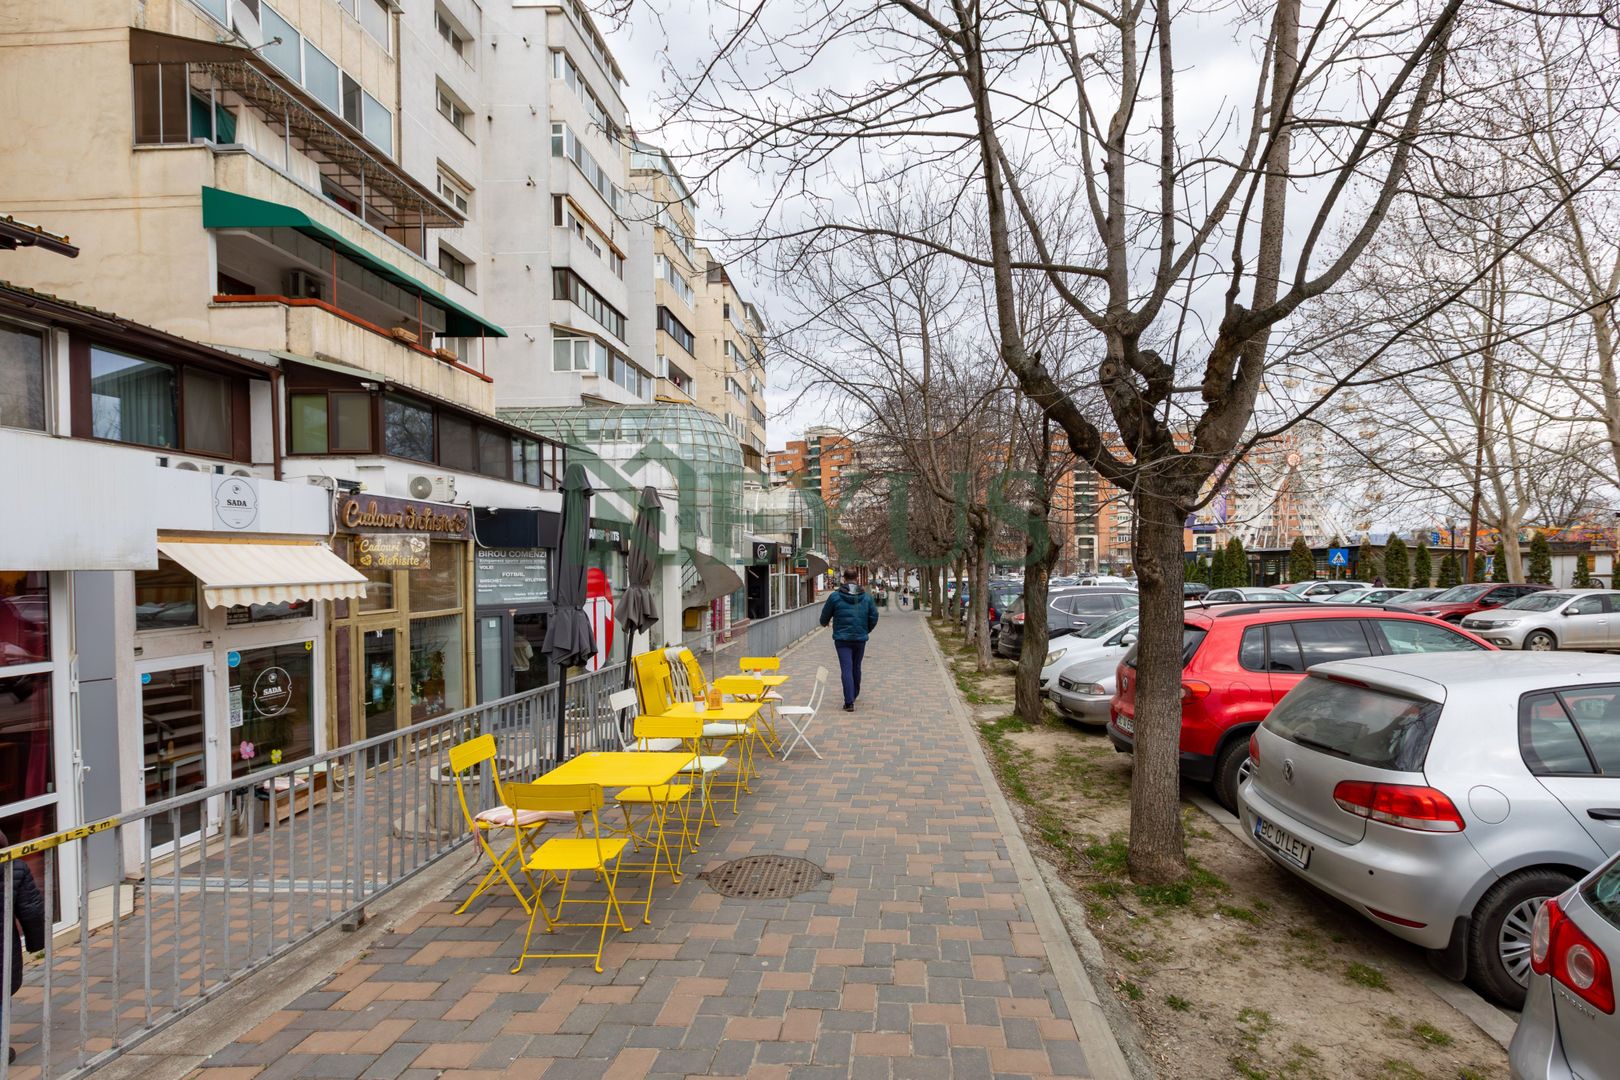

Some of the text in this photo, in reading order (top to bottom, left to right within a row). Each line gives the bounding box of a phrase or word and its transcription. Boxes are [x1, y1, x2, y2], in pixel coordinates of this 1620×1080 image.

[226, 499, 247, 507] SADA
[342, 500, 403, 529] Cadouri
[360, 540, 401, 553] Cadouri
[378, 553, 420, 566] dichisite
[478, 550, 506, 558] BIROU
[262, 687, 282, 695] SADA
[1261, 820, 1306, 859] BC 01 LET
